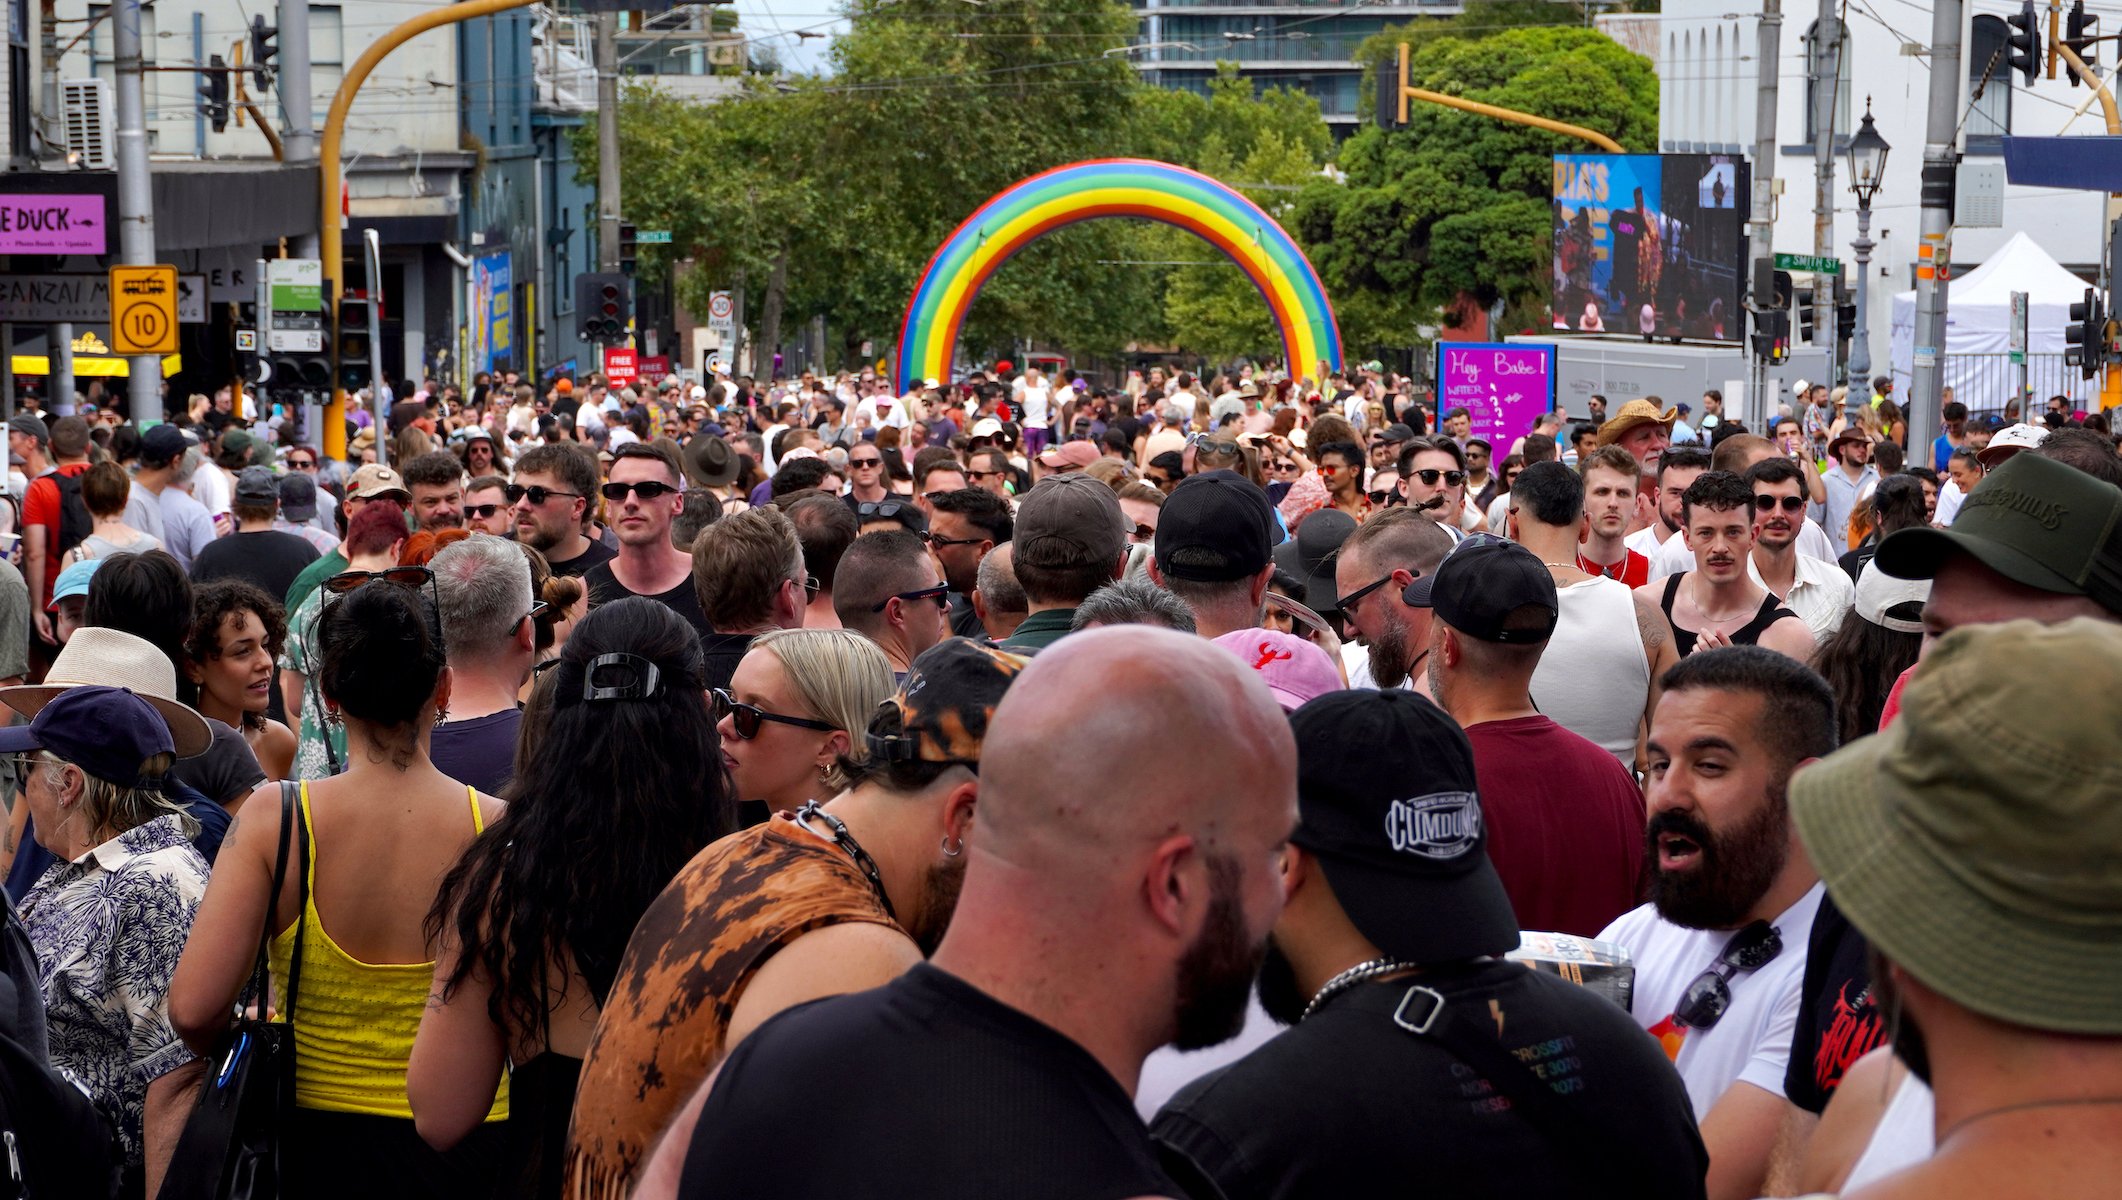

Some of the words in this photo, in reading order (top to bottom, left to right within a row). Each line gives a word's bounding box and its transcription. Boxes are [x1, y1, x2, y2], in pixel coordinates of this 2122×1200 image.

[17, 208, 69, 231] DUCK
[1793, 255, 1823, 267] SMITH
[1825, 258, 1837, 269] ST
[715, 301, 728, 311] 30
[135, 314, 156, 336] 10
[306, 338, 318, 348] 15
[611, 356, 632, 366] FREE
[607, 367, 635, 377] WATER
[640, 363, 662, 371] FREE
[1451, 351, 1482, 383] Hey
[1447, 385, 1484, 395] WATER
